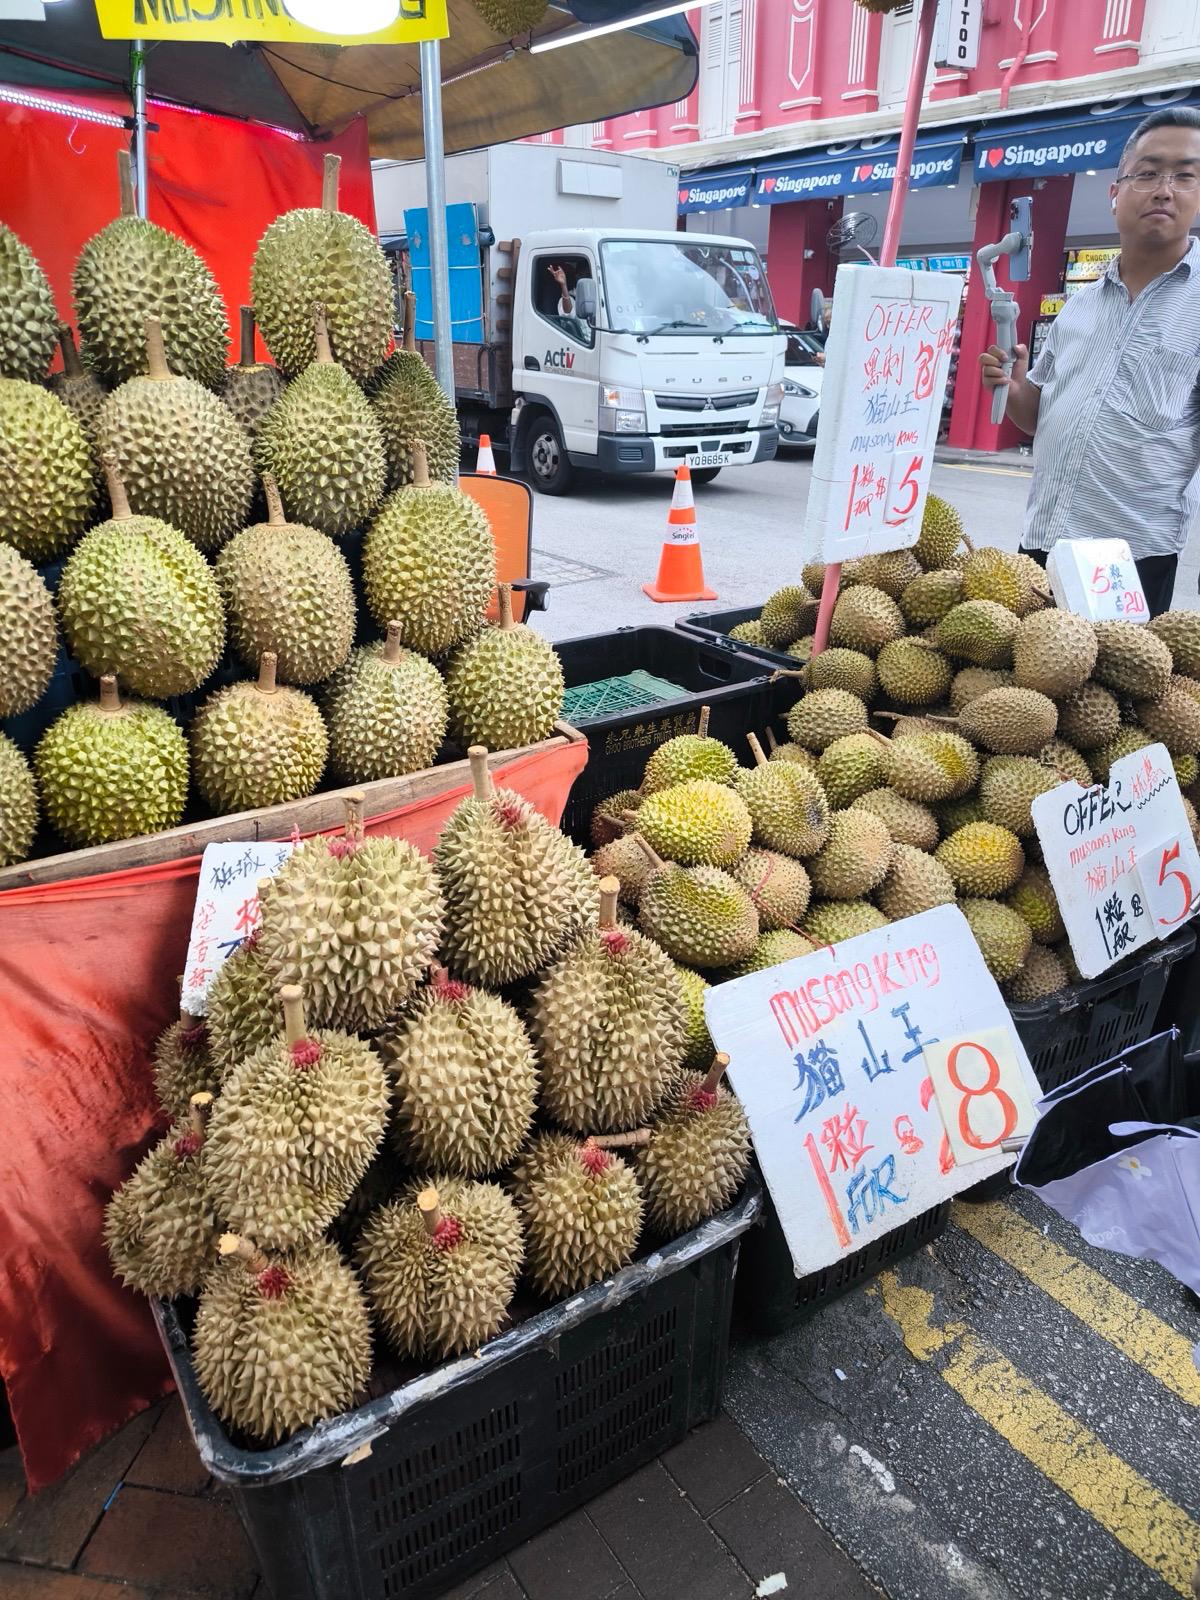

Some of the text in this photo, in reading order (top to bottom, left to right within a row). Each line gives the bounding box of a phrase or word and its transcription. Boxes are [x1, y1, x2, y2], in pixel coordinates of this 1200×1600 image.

[1003, 139, 1106, 166] Singapore
[688, 185, 747, 204] Singapore
[774, 172, 841, 193] Singapore
[865, 302, 938, 341] OFFER
[544, 347, 575, 368] Activ
[1063, 781, 1132, 836] OFFER
[1113, 921, 1137, 957] FOR
[847, 1153, 910, 1234] FOR
